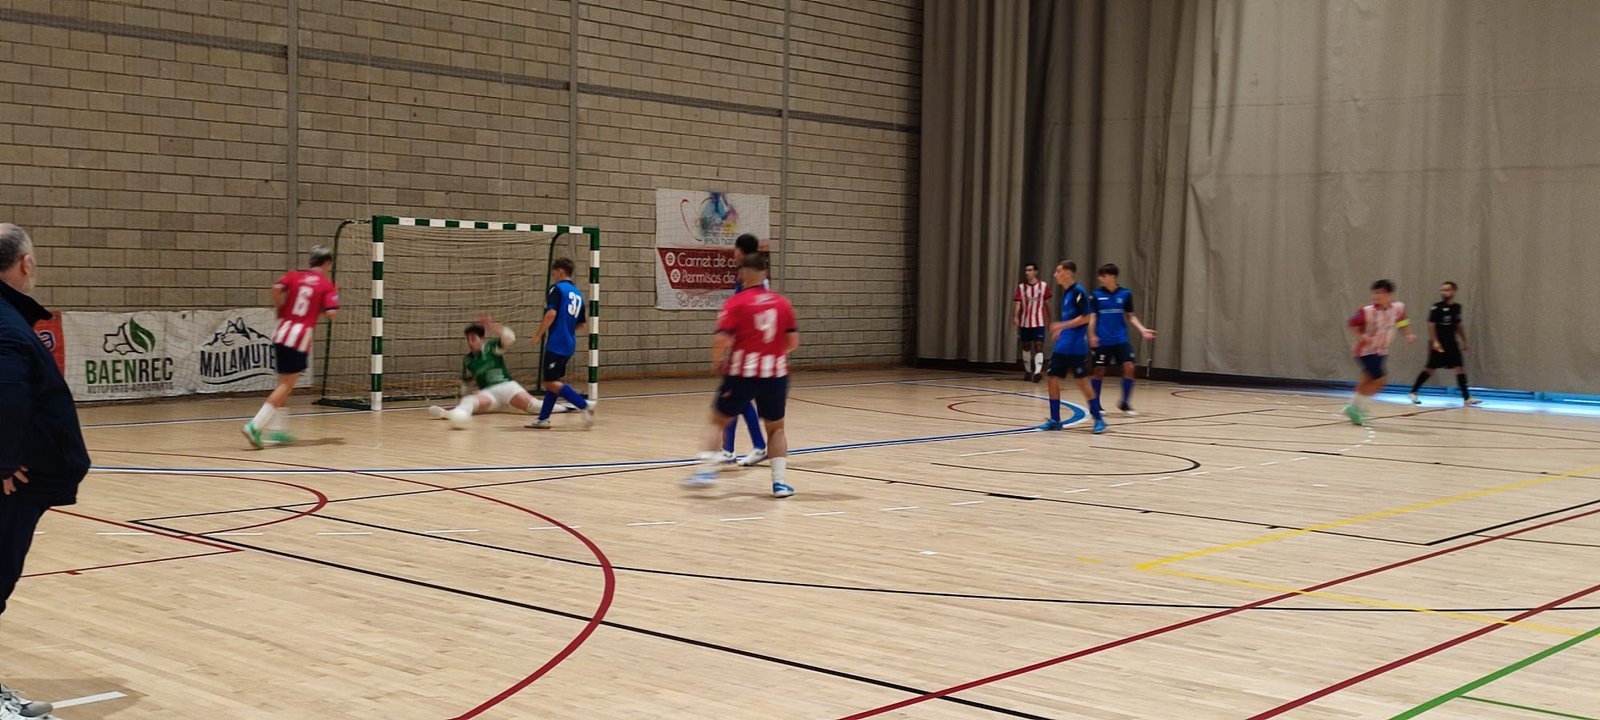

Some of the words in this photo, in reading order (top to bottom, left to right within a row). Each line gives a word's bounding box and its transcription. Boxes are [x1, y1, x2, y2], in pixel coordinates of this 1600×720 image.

[677, 252, 712, 268] Carnet
[713, 253, 726, 268] de
[682, 269, 721, 284] Permisos
[722, 270, 736, 284] de
[291, 286, 314, 317] 6
[567, 291, 583, 319] 37
[85, 357, 174, 385] BAENREC
[200, 343, 276, 378] MALAMUTE
